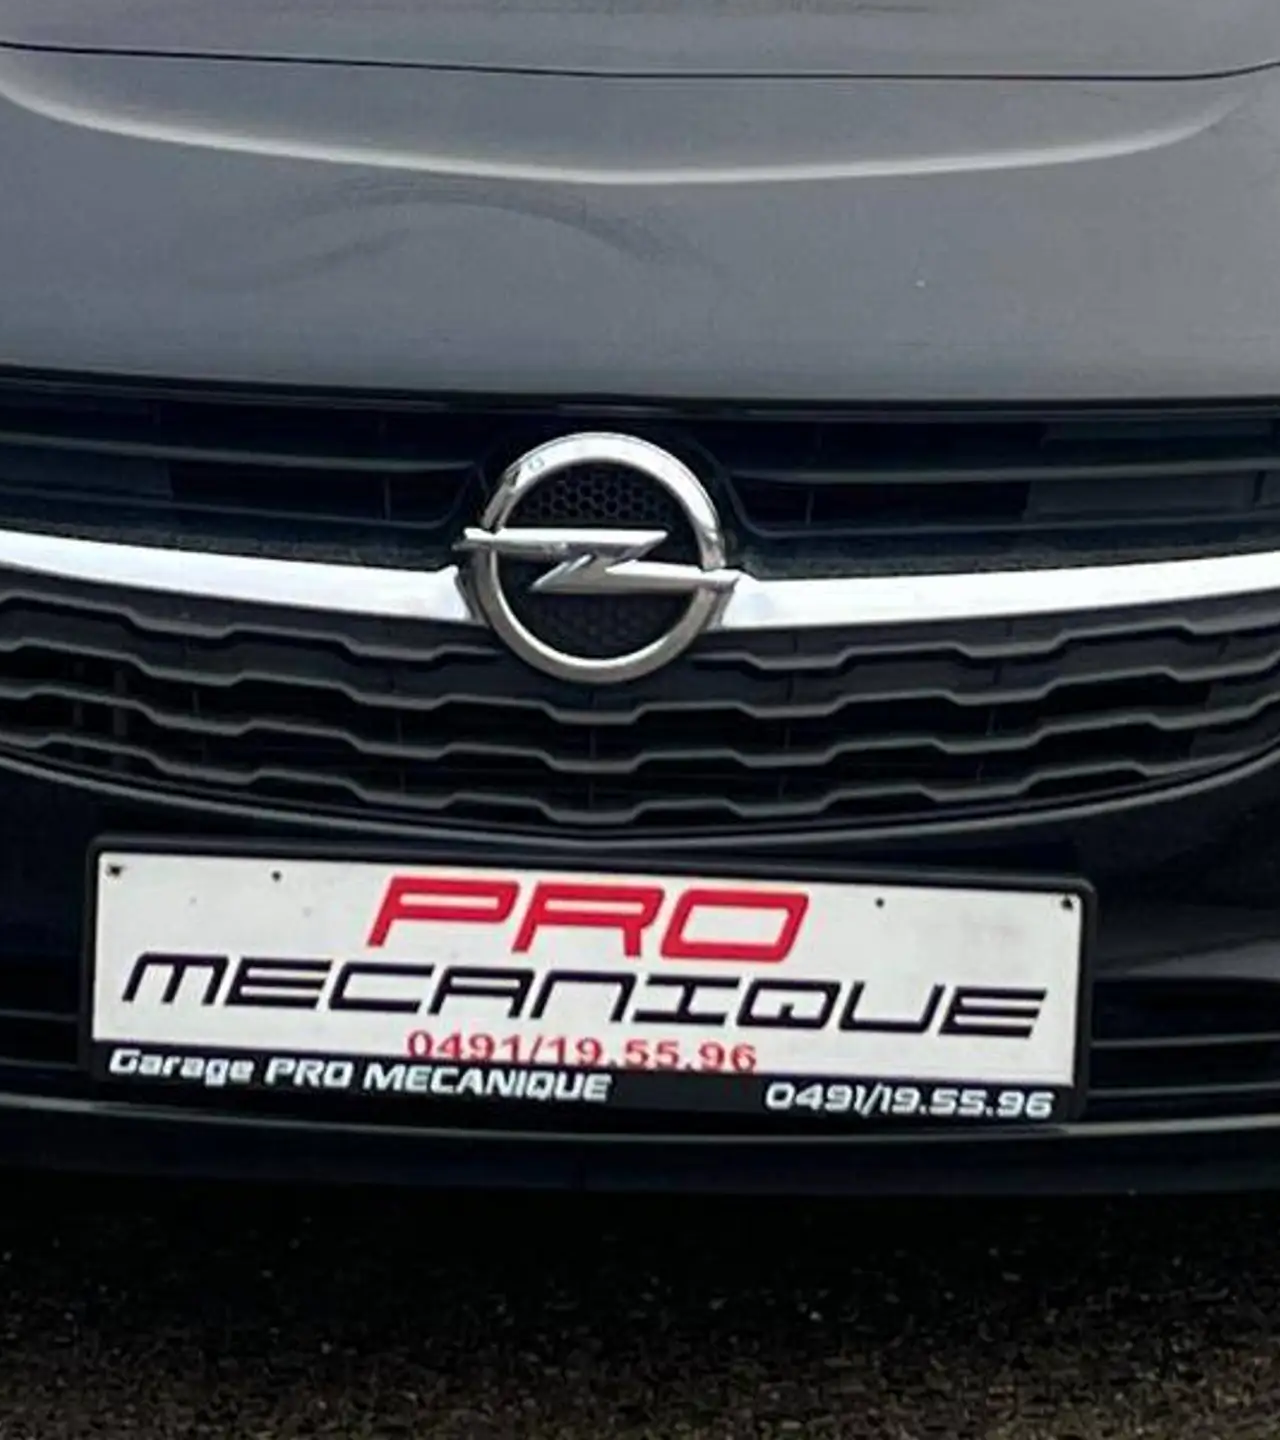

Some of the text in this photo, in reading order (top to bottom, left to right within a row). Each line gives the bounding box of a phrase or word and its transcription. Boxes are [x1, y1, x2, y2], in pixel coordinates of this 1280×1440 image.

[366, 873, 811, 963] PRO
[122, 951, 1048, 1038] MECANIQUE
[109, 1048, 612, 1101] Garage PRO MECANIQUE
[407, 1029, 757, 1073] 0491/19.55.96
[765, 1084, 1056, 1118] 0491/19.55.96
